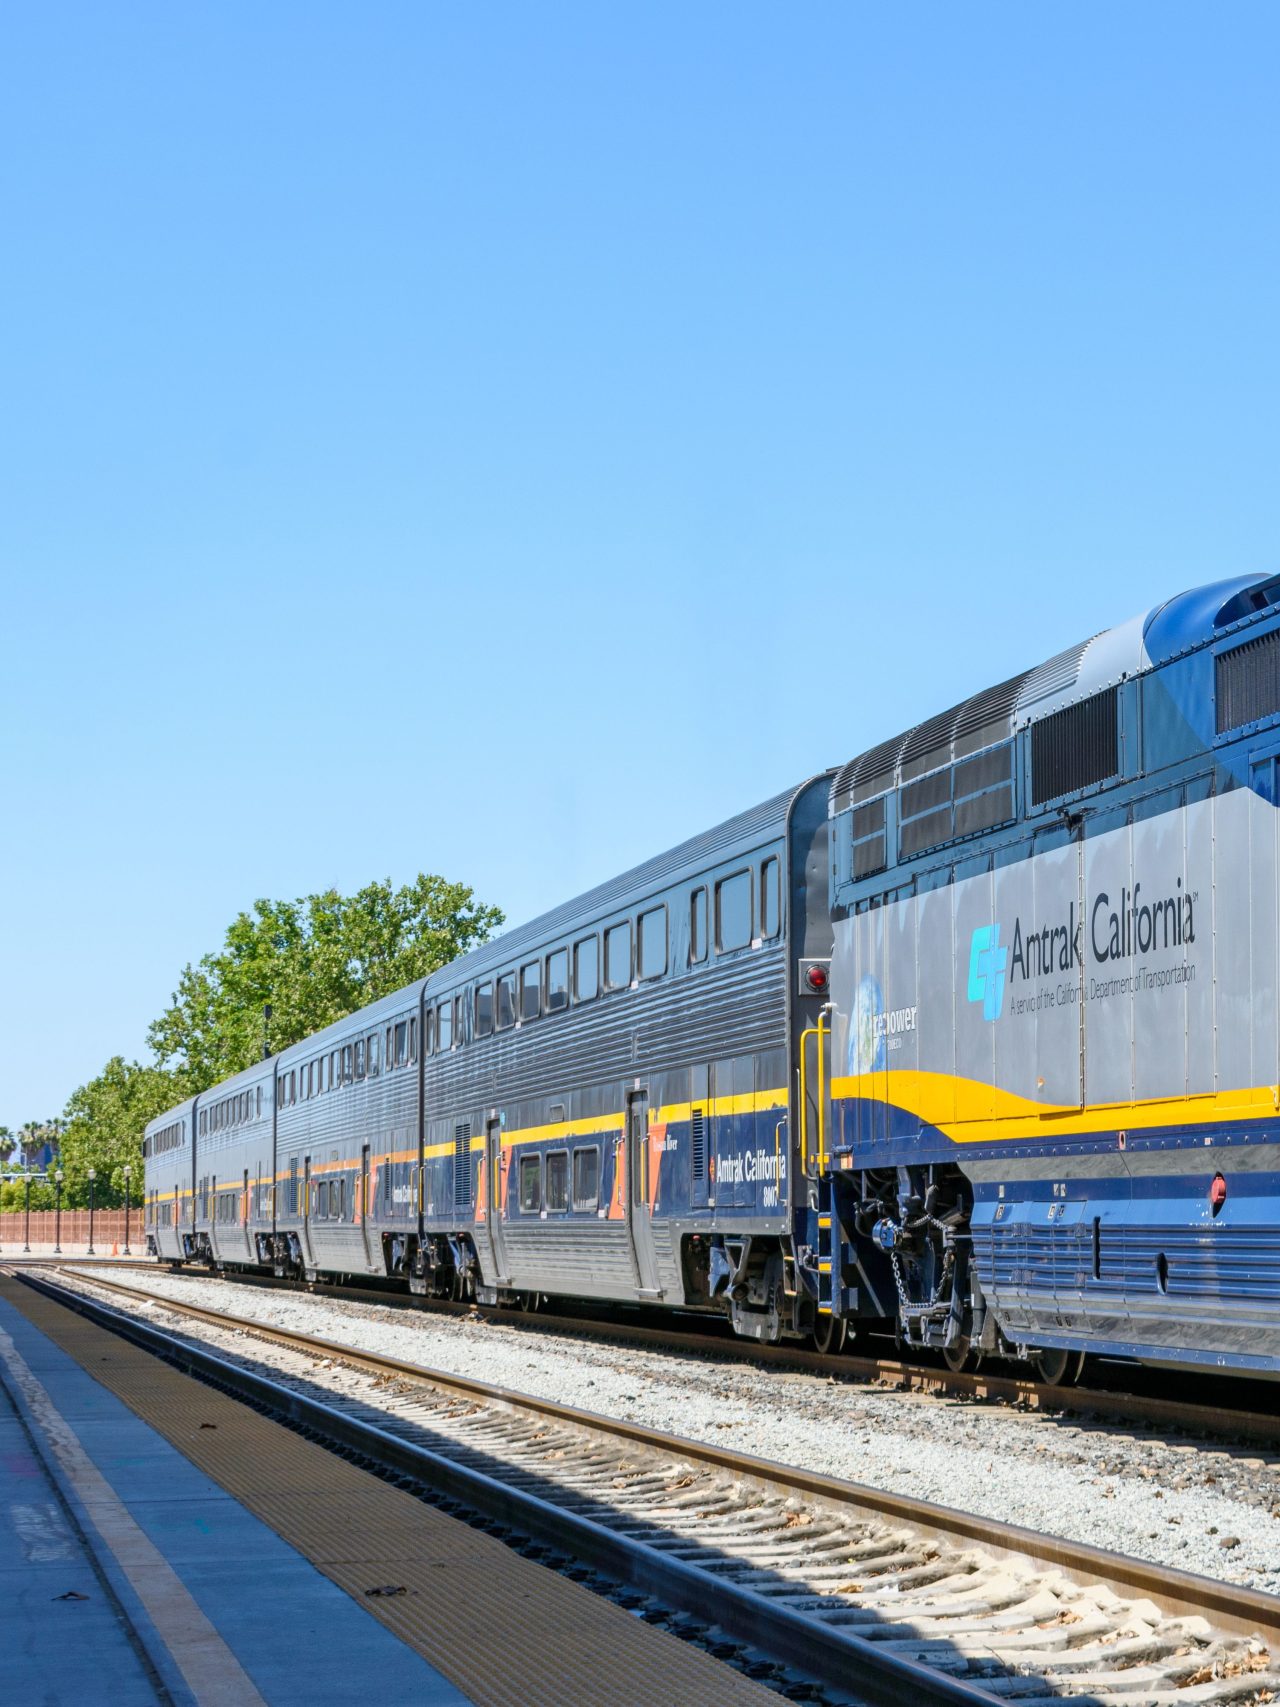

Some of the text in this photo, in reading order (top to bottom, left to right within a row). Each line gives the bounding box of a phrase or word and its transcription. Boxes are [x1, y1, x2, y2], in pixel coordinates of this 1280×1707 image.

[1009, 901, 1081, 984] Amtrak
[1091, 876, 1195, 963] California
[1017, 991, 1037, 1015] servic
[1044, 986, 1055, 1009] the
[1056, 981, 1089, 1006] Californa
[1091, 976, 1133, 1005] Department
[1141, 962, 1196, 994] Transportation
[716, 1147, 787, 1184] Amtrak California
